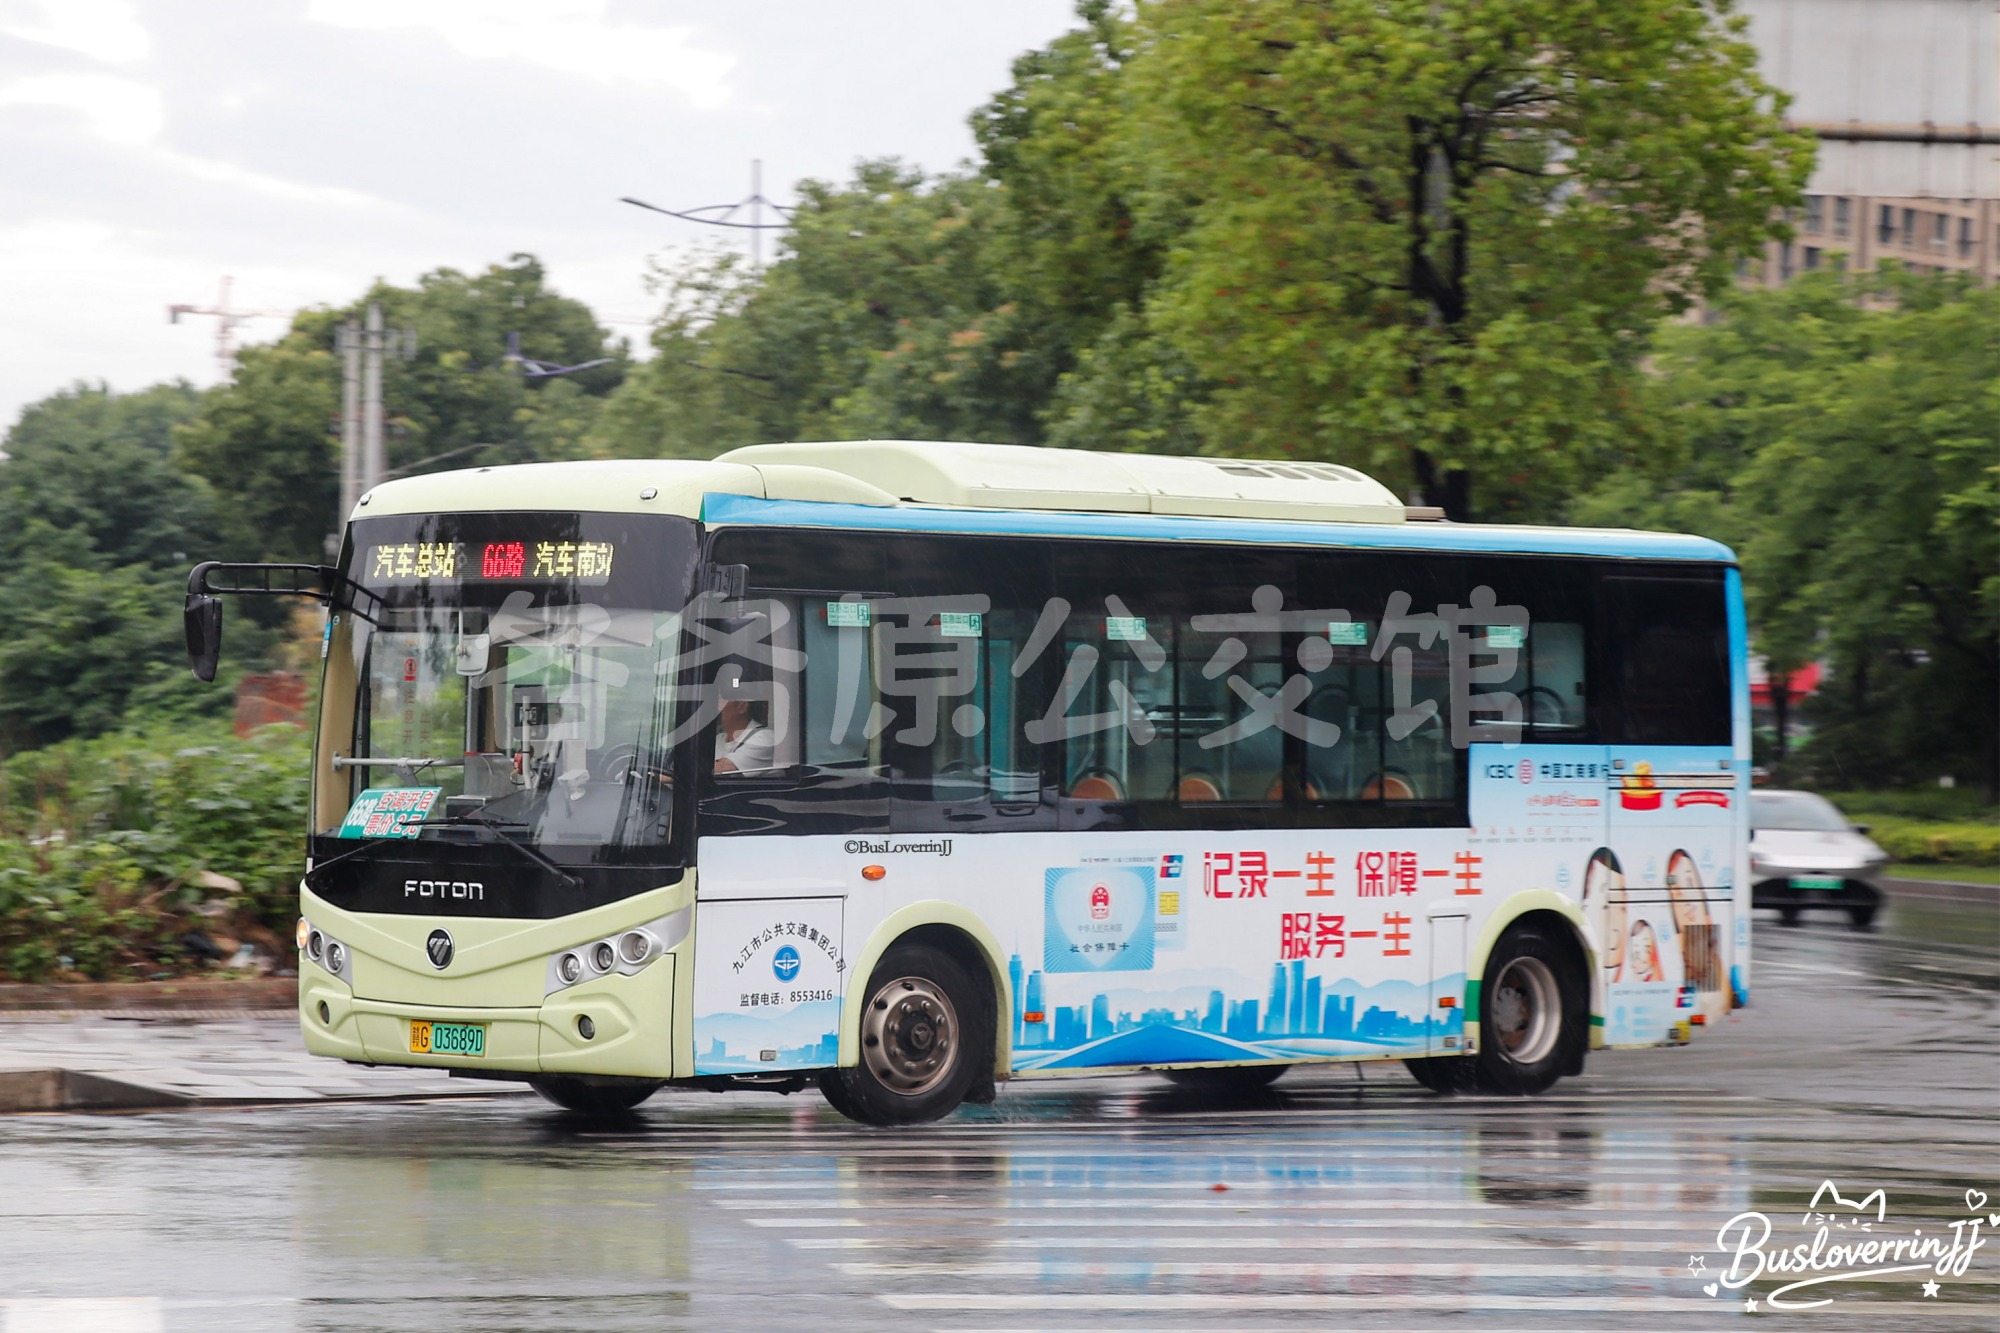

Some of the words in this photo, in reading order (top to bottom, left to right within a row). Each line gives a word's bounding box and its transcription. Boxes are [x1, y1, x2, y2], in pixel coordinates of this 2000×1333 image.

[373, 541, 456, 578] 汽车总站
[482, 541, 526, 578] 66路
[533, 540, 614, 578] 汽车南站
[375, 791, 437, 812] 空调开启
[404, 880, 485, 900] FOTON
[1203, 850, 1336, 899] 记录一生
[1355, 850, 1483, 898] 保障一生
[732, 921, 847, 974] 九江市公共交通集团公司
[1069, 942, 1130, 953] 社会保障卡
[1280, 911, 1412, 960] 服务一生
